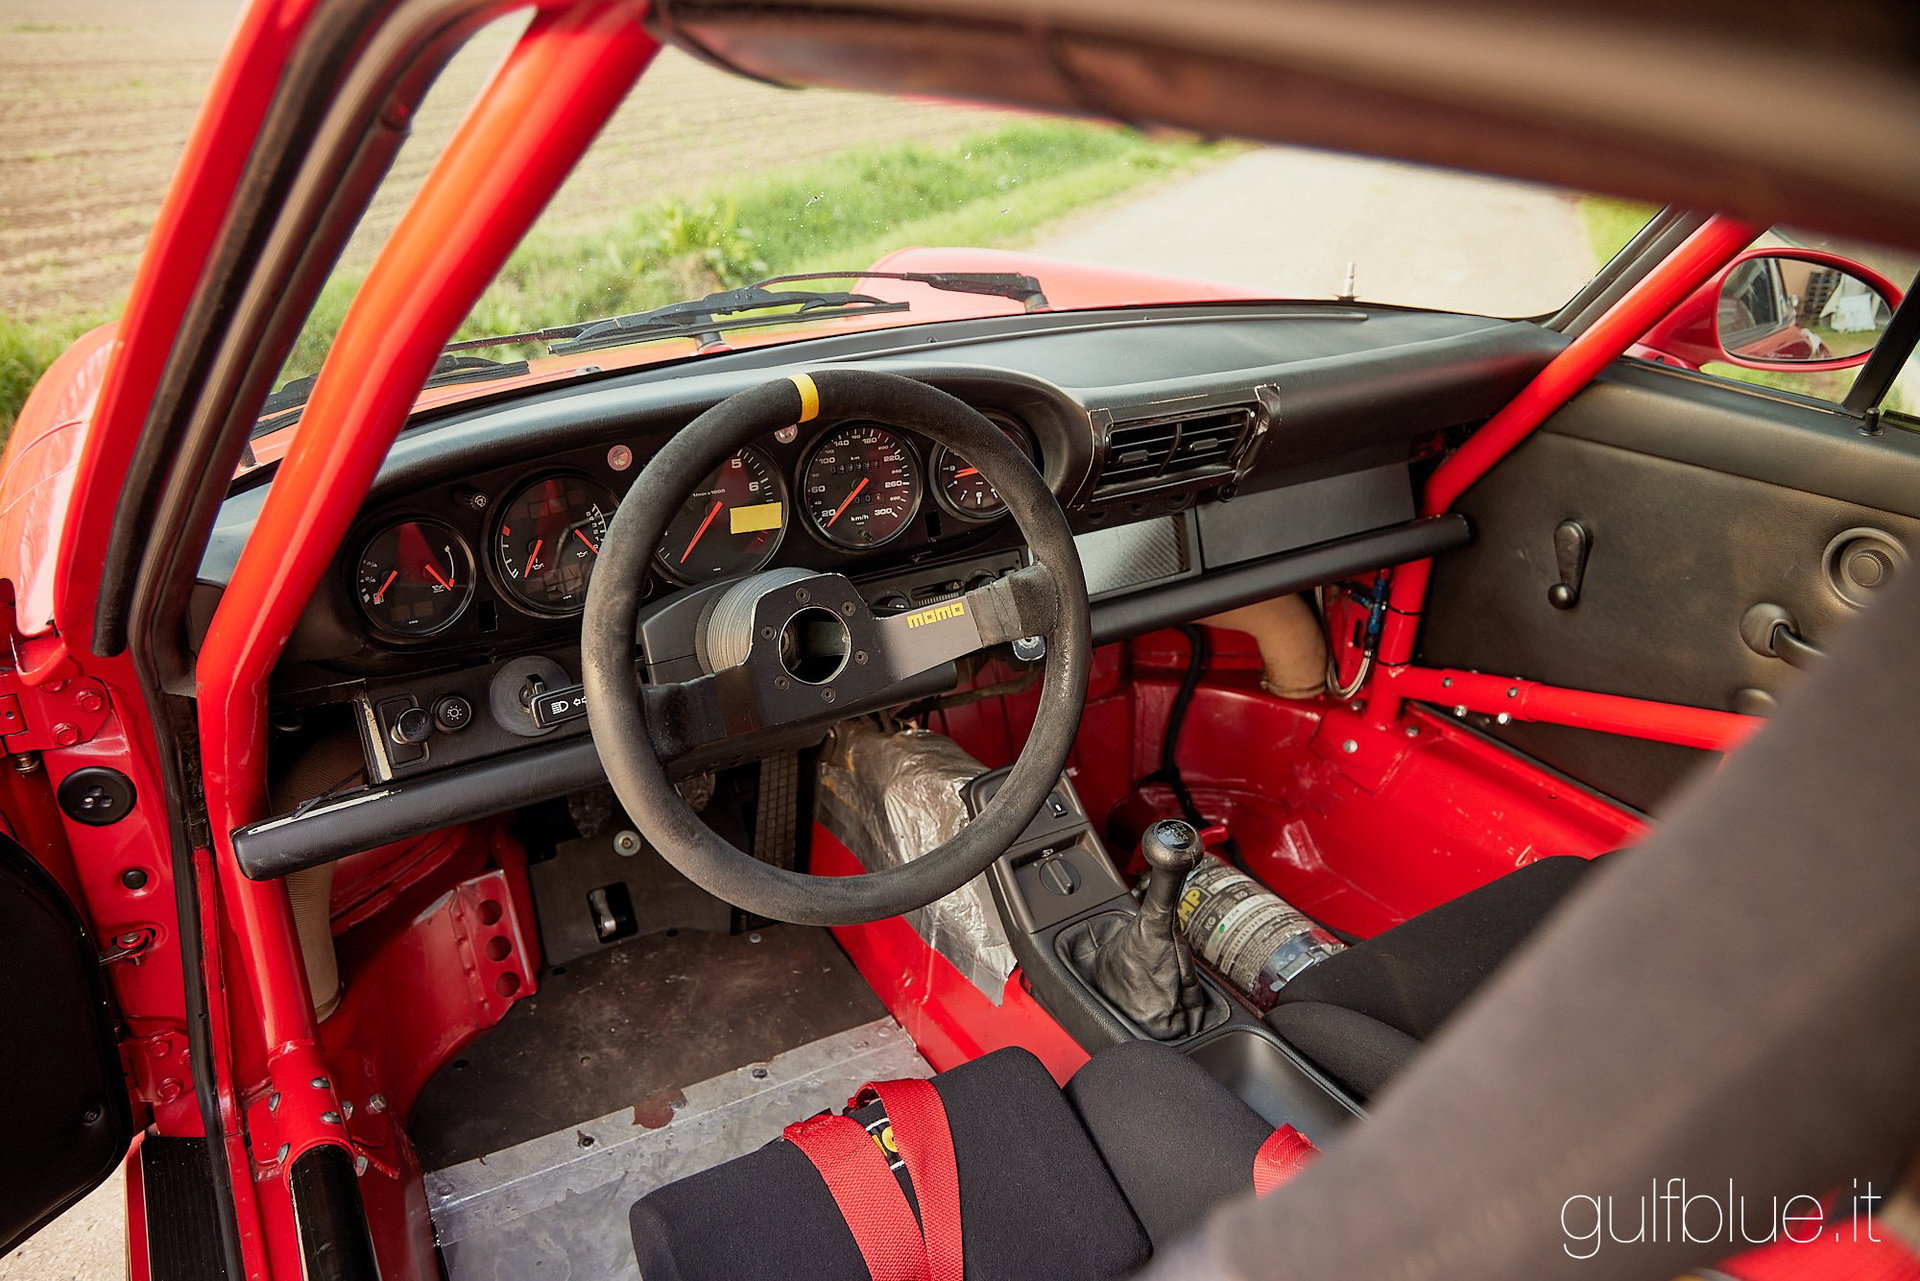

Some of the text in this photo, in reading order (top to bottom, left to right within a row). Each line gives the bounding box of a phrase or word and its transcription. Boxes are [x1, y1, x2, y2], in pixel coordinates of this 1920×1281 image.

[834, 439, 850, 447] 140
[819, 456, 836, 464] 100
[883, 454, 900, 462] 220
[731, 458, 742, 469] 5
[748, 482, 759, 492] 6
[884, 480, 903, 488] 260
[811, 485, 826, 494] 60
[821, 509, 836, 518] 20
[874, 507, 893, 516] 300
[1204, 916, 1217, 931] KG
